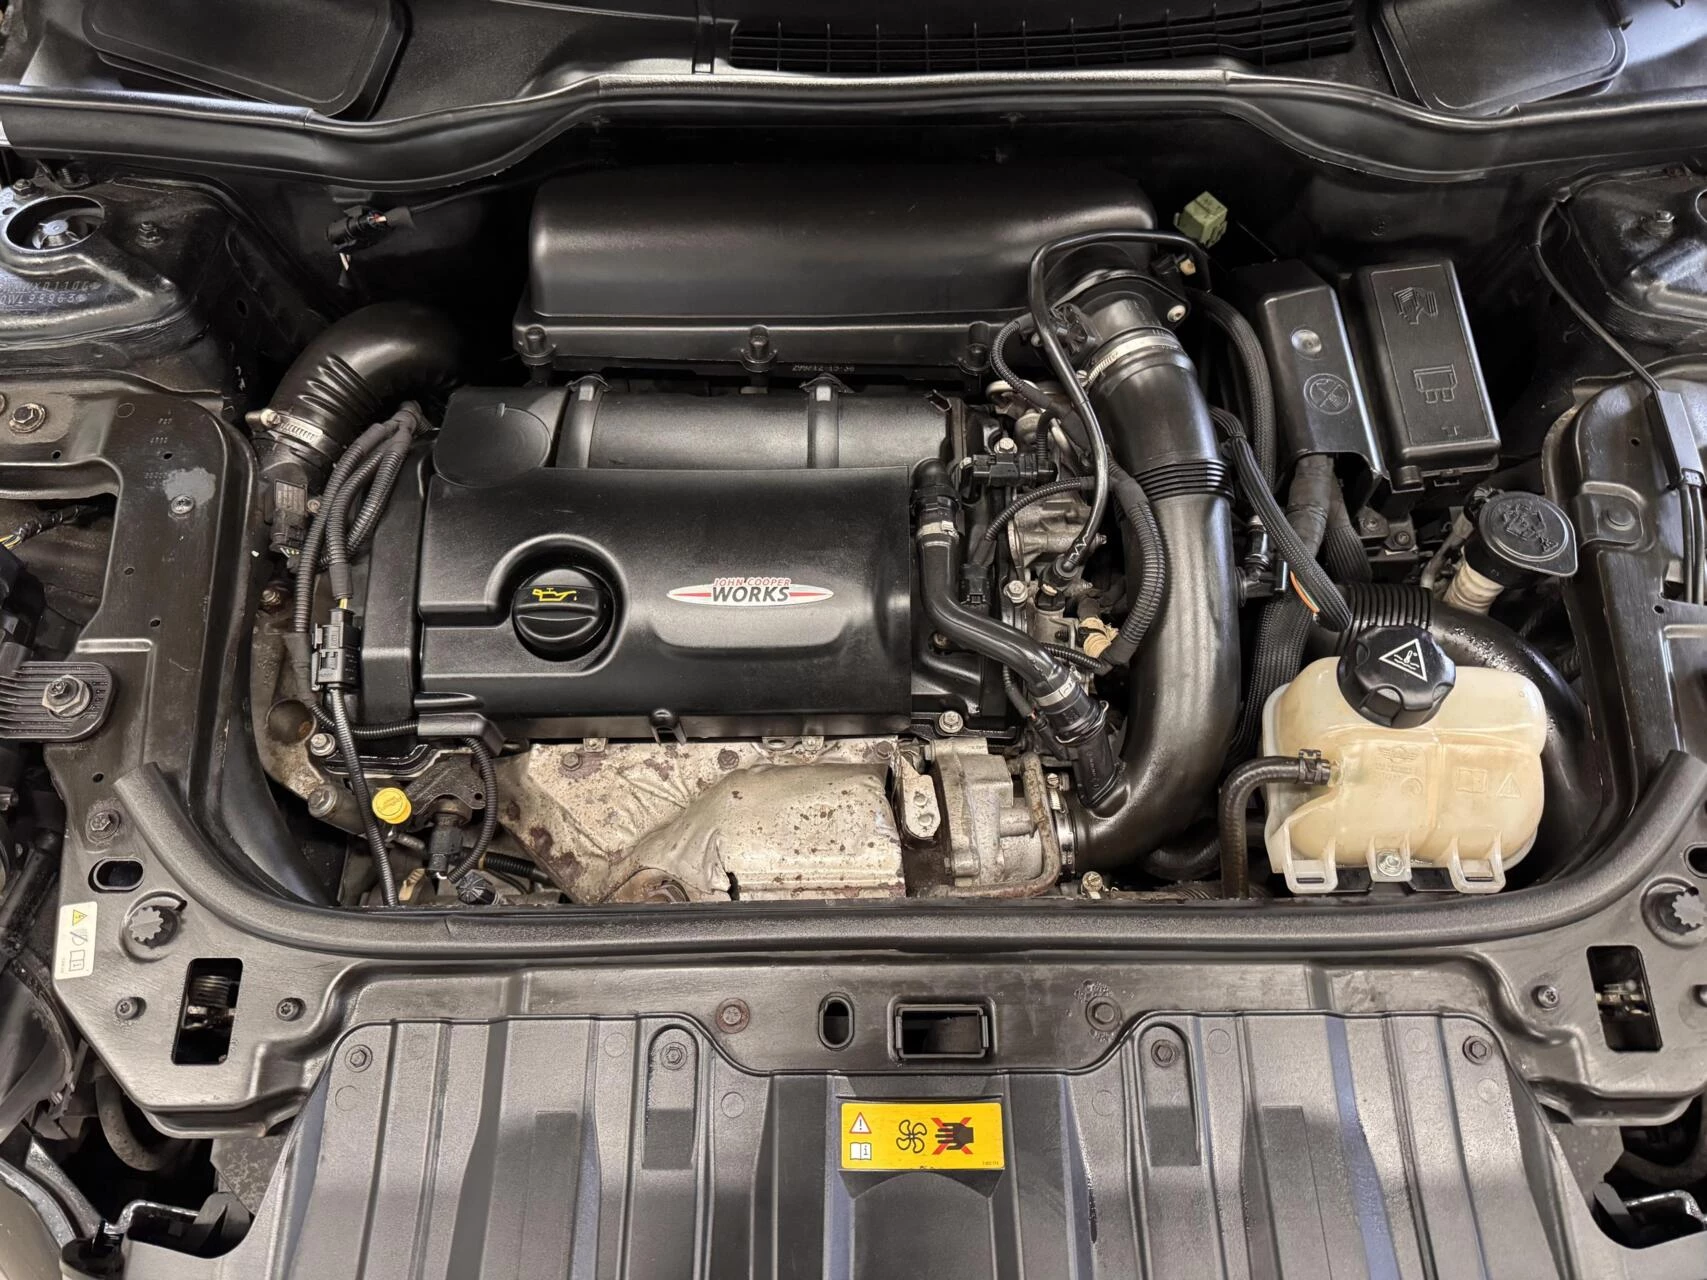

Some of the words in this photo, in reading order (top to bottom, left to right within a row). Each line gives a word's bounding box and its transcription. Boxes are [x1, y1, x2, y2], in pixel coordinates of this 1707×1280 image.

[713, 577, 745, 587] JOHN
[747, 577, 791, 586] COOPER
[712, 586, 790, 602] WORKS
